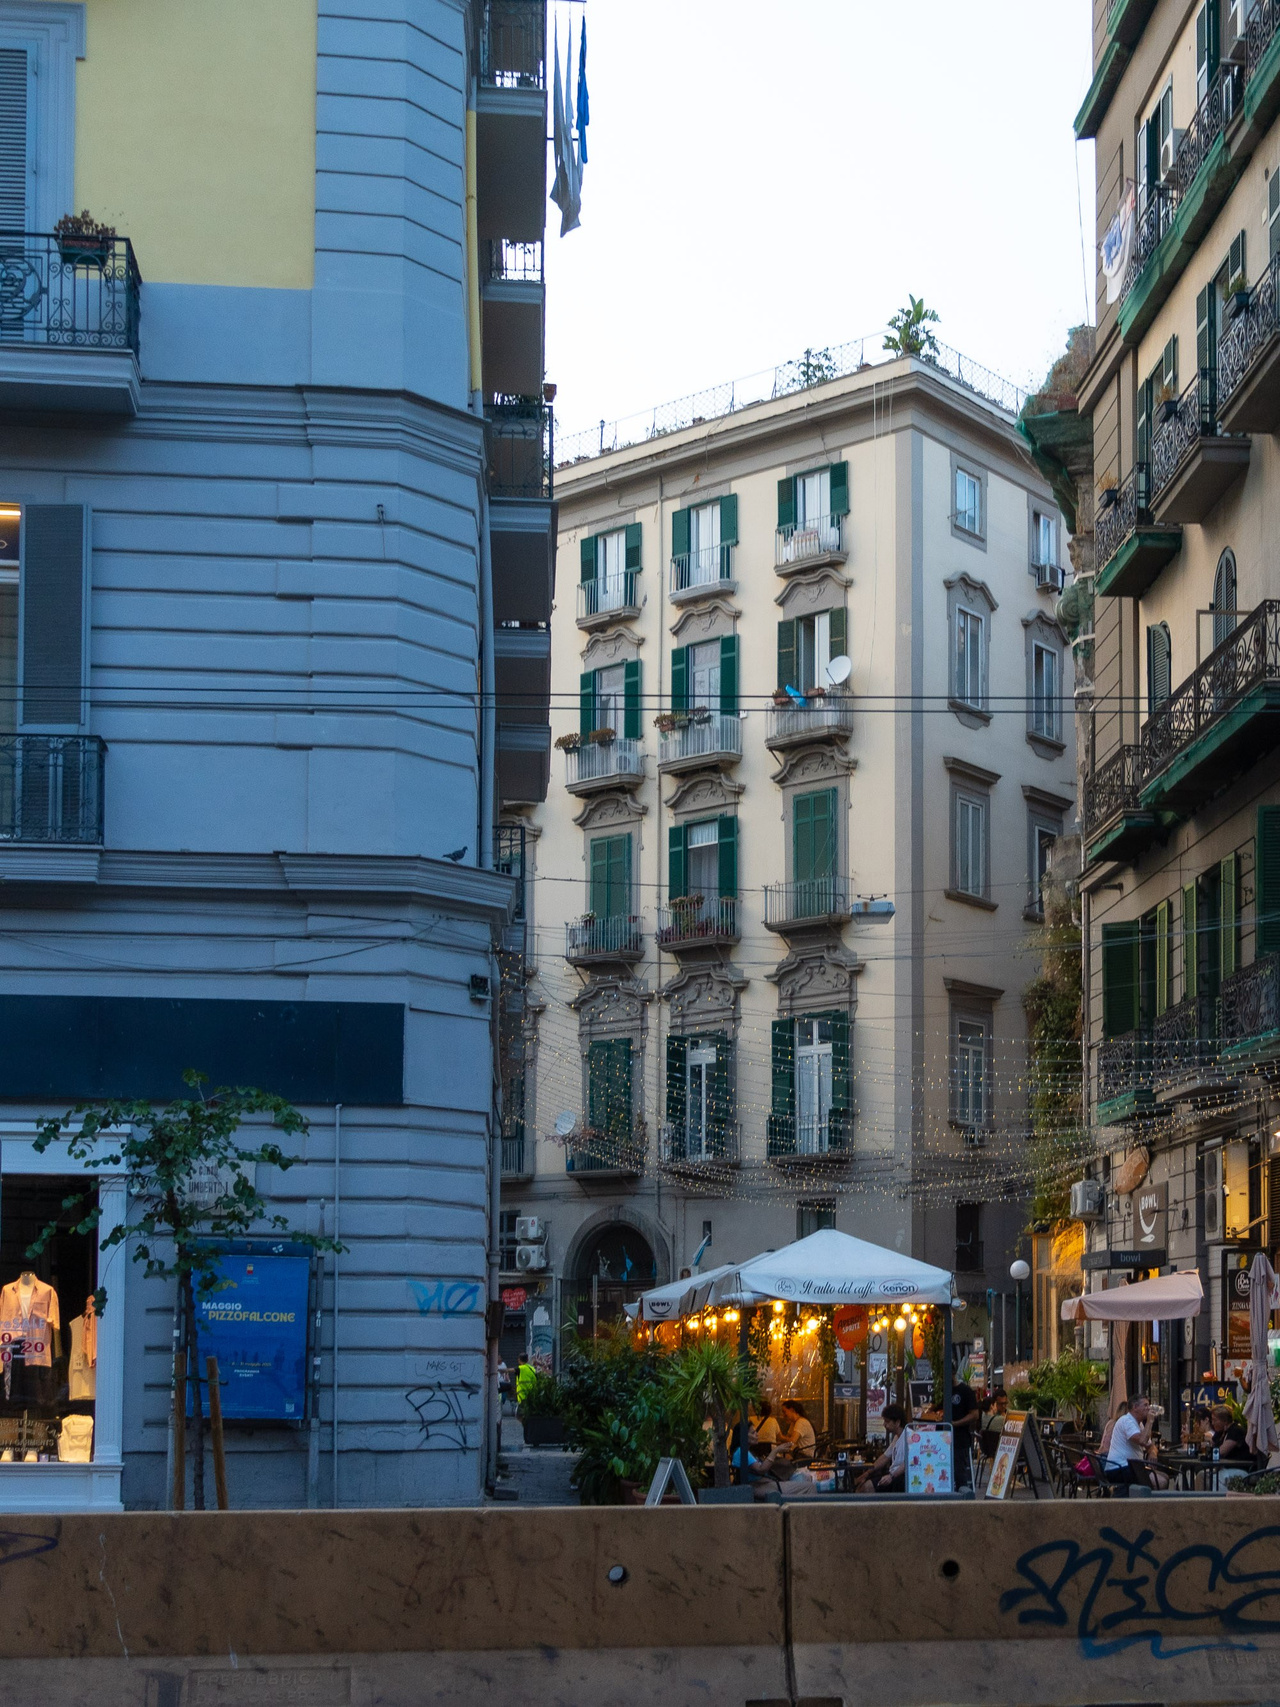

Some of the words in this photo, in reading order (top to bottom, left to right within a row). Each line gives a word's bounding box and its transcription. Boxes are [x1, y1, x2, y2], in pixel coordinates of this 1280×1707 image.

[1140, 1193, 1157, 1211] BOWL
[1120, 1253, 1141, 1263] bowl
[813, 1280, 836, 1295] culto
[837, 1281, 853, 1295] del
[201, 1302, 242, 1310] MAGGIO
[1231, 1301, 1251, 1311] ZINGA
[208, 1310, 296, 1323] PIZZOFALCONE
[22, 1341, 45, 1353] 20
